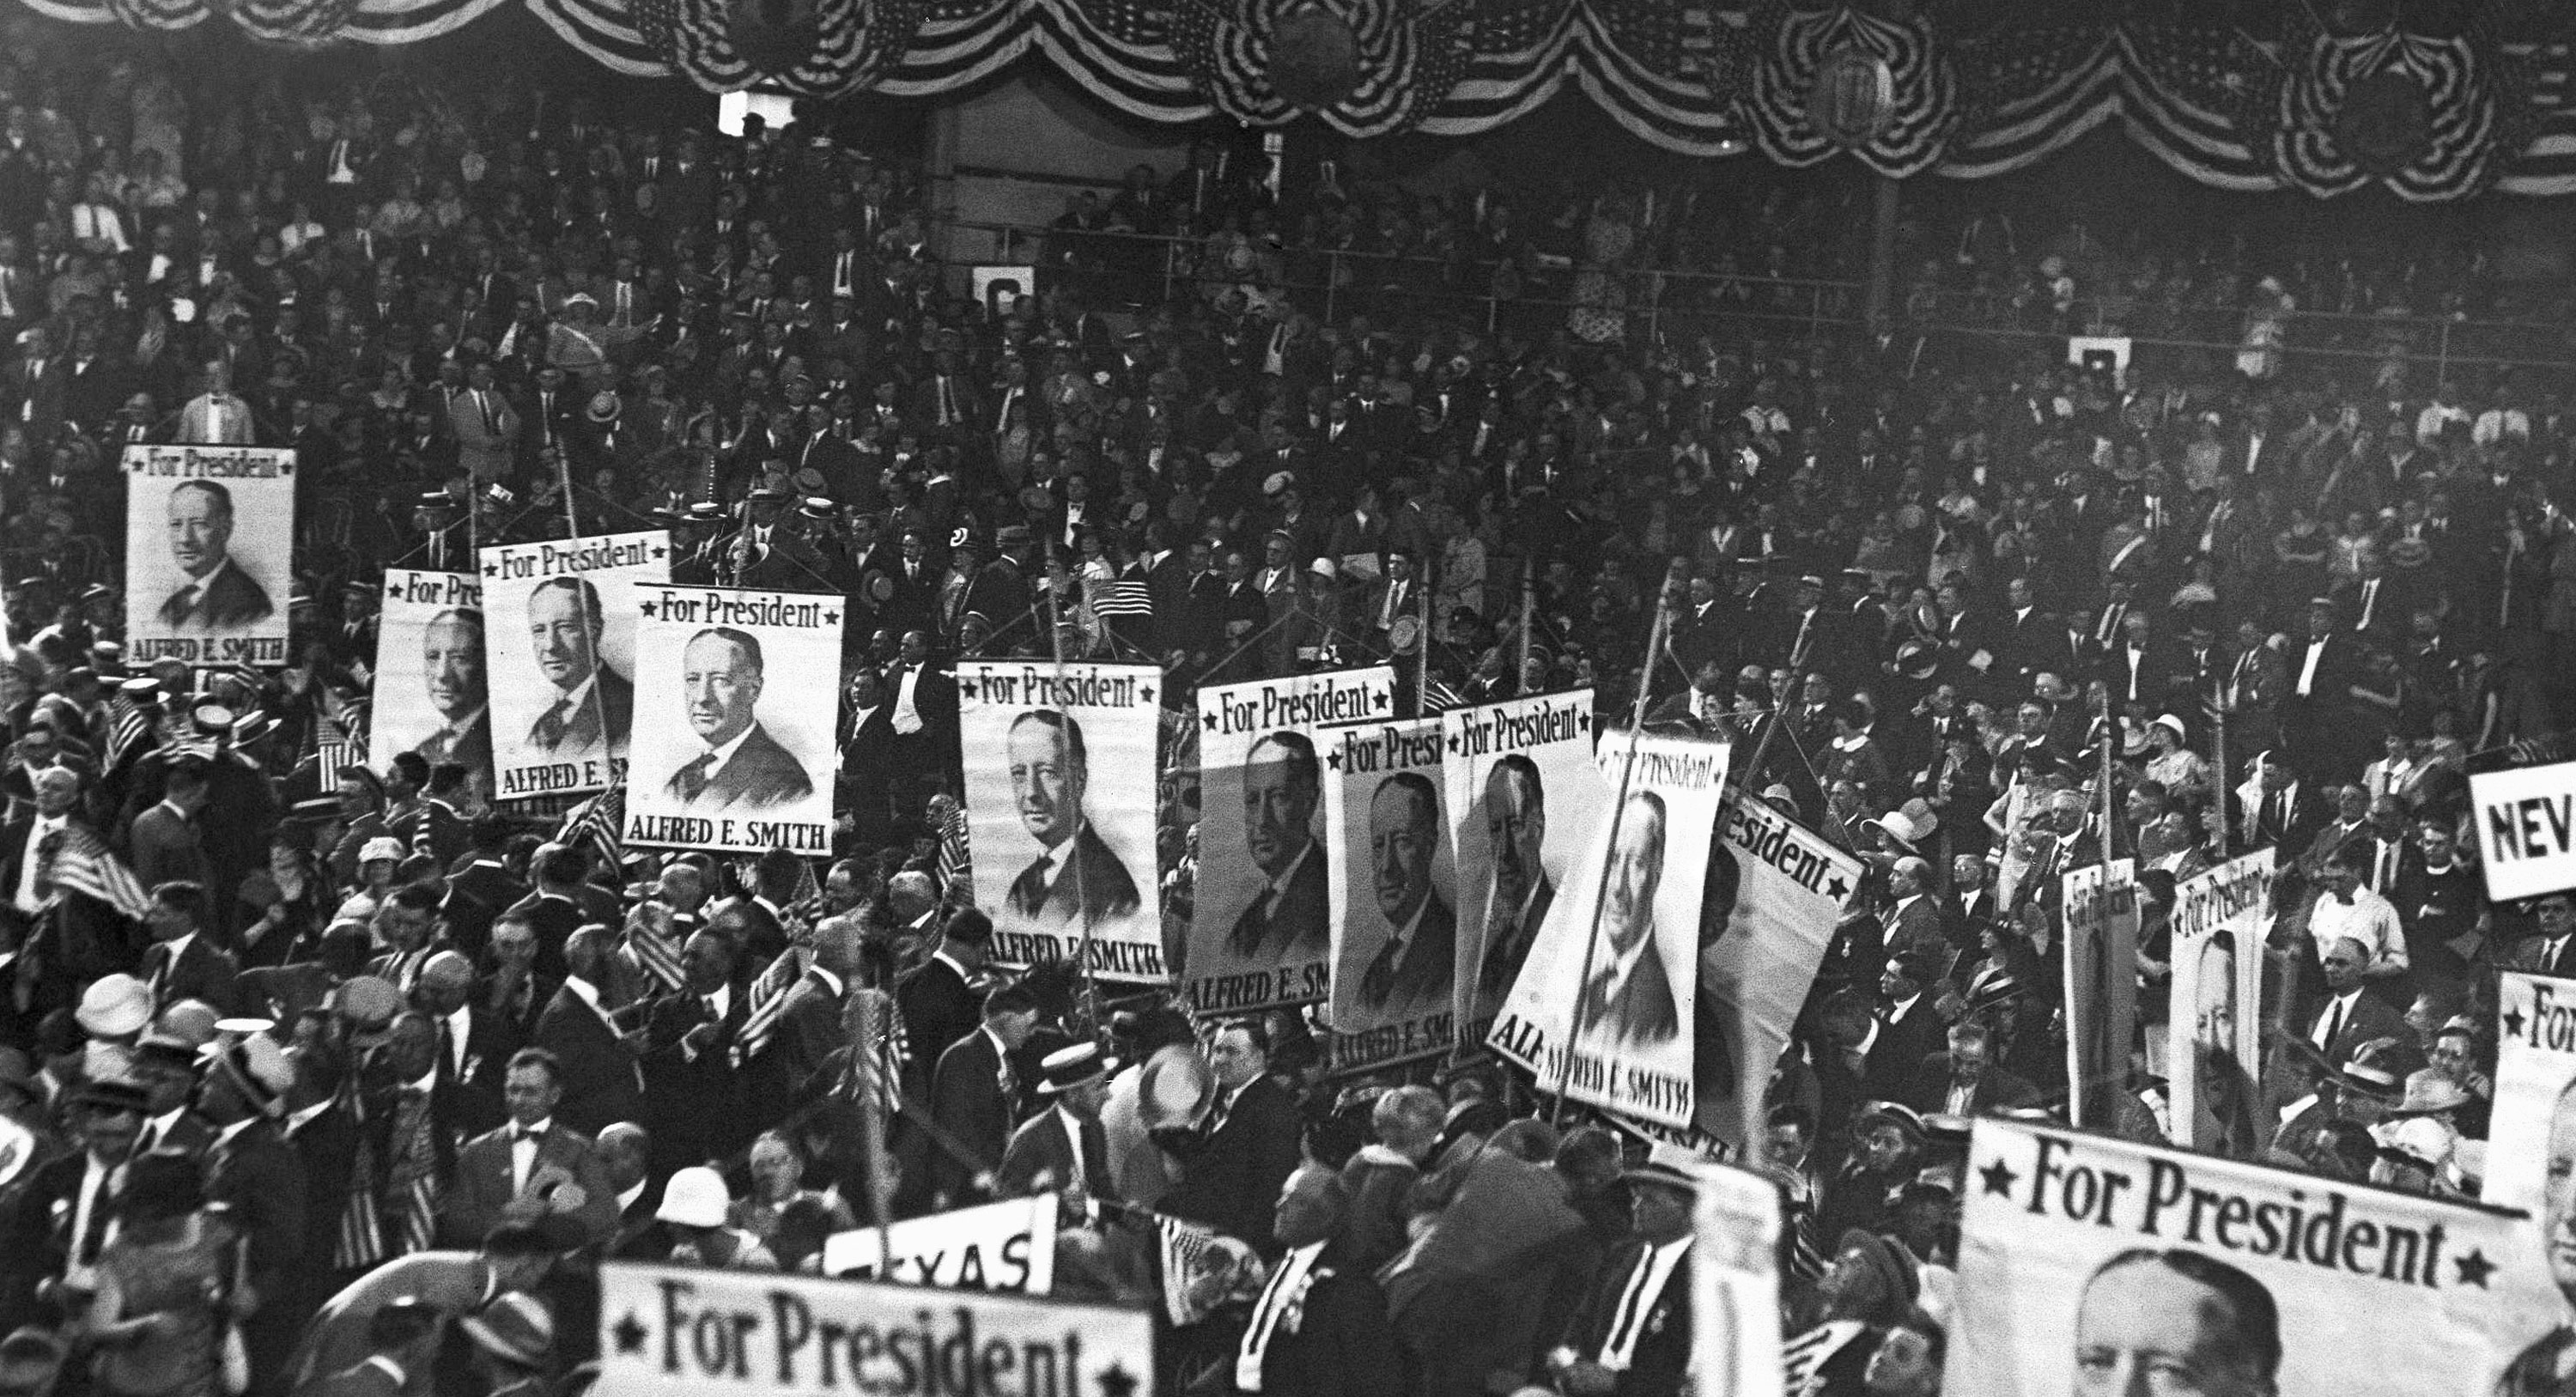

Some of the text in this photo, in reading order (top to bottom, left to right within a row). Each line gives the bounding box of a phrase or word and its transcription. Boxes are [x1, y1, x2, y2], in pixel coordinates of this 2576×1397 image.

[149, 447, 277, 478] For President
[500, 538, 648, 580] For President
[407, 573, 442, 604] For
[660, 591, 820, 628] For President
[979, 666, 1135, 708] For President
[1219, 678, 1371, 734] For President
[1343, 724, 1443, 774] For Presi
[1460, 700, 1577, 757] For President
[502, 762, 579, 794] ALFRED
[583, 760, 604, 787] E.
[628, 815, 827, 850] ALFRED E. SMITH
[1722, 807, 1832, 895] esident
[987, 932, 1062, 964] ALFRED
[1090, 938, 1163, 975] SMITH
[1188, 971, 1272, 1010] ALFRED
[2530, 981, 2576, 1054] For
[2026, 1135, 2446, 1288] For President
[657, 1279, 1080, 1397] For President
